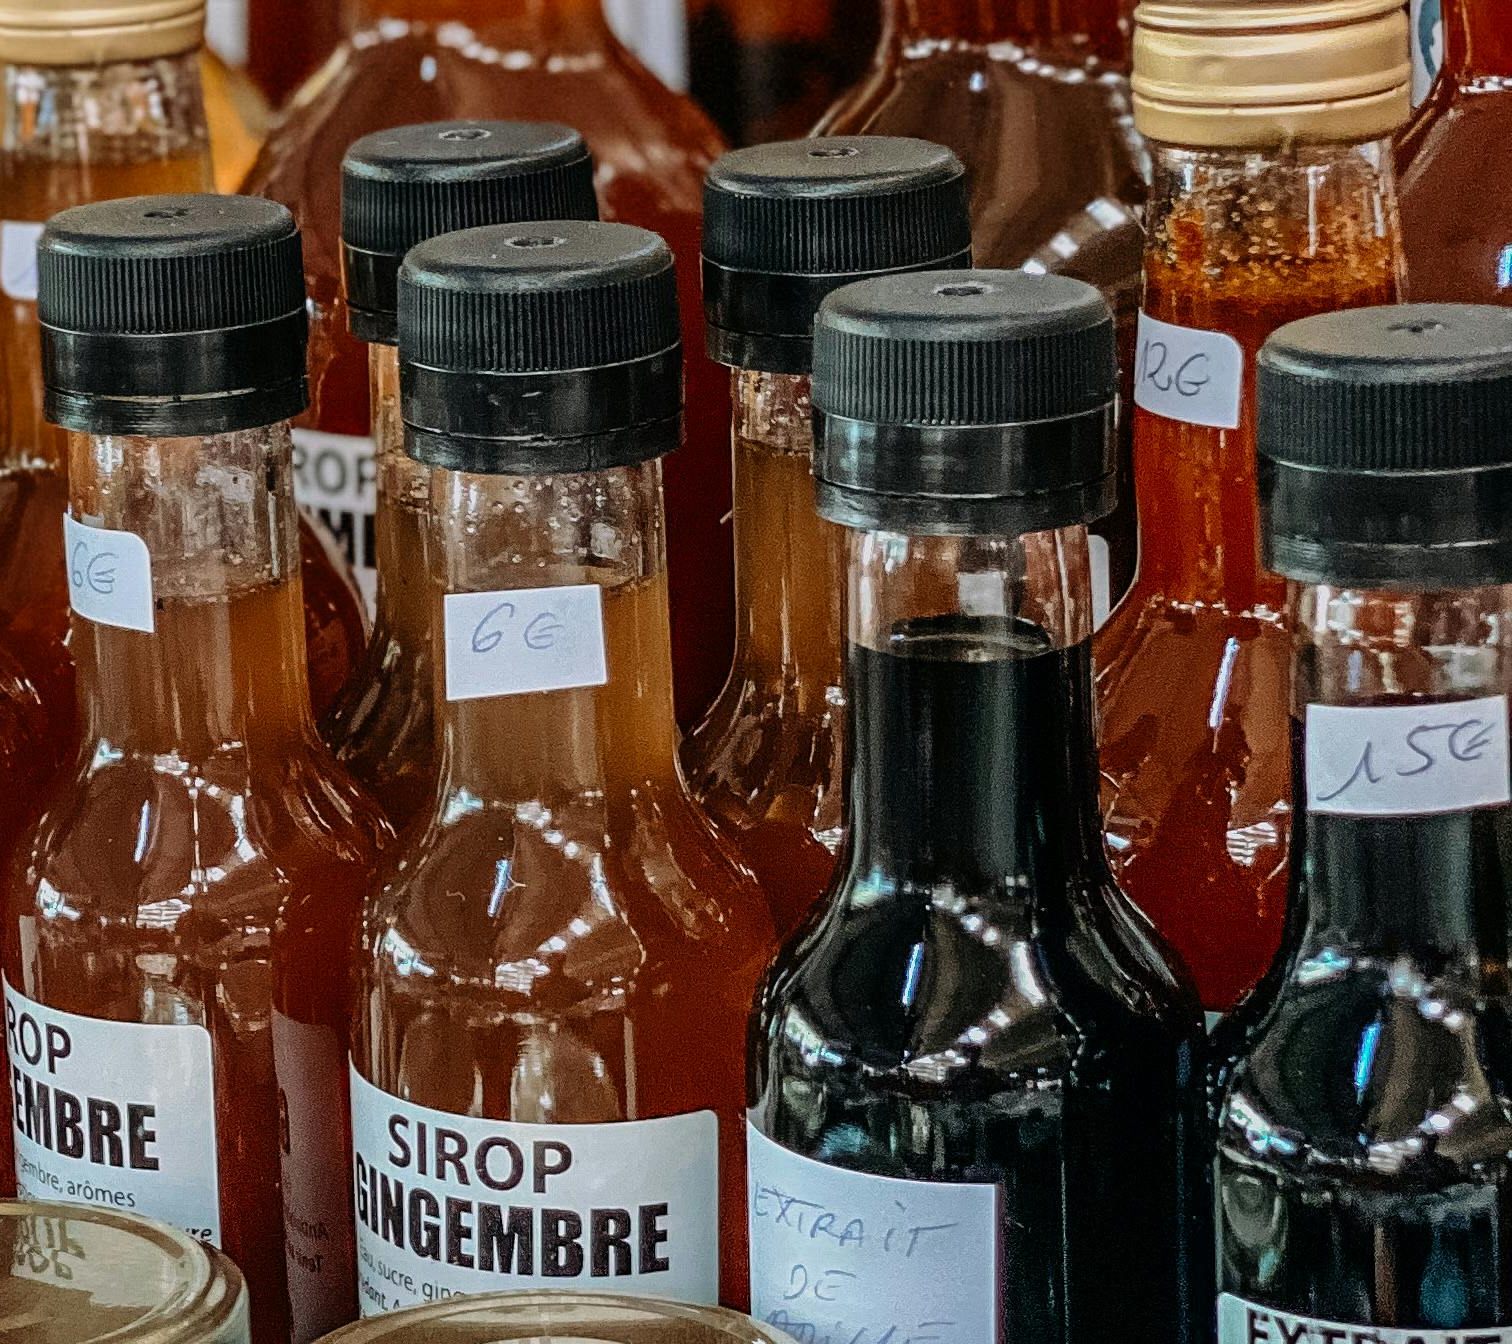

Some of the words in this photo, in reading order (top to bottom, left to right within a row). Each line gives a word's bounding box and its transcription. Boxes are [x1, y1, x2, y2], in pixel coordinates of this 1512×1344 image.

[472, 602, 565, 653] 6€
[1315, 719, 1496, 802] 15€
[6, 997, 71, 1074] ROP
[12, 1063, 160, 1171] EMBRE
[388, 1114, 572, 1193] SIROP
[67, 1180, 136, 1208] arômes
[356, 1151, 670, 1277] GINGEMBRE
